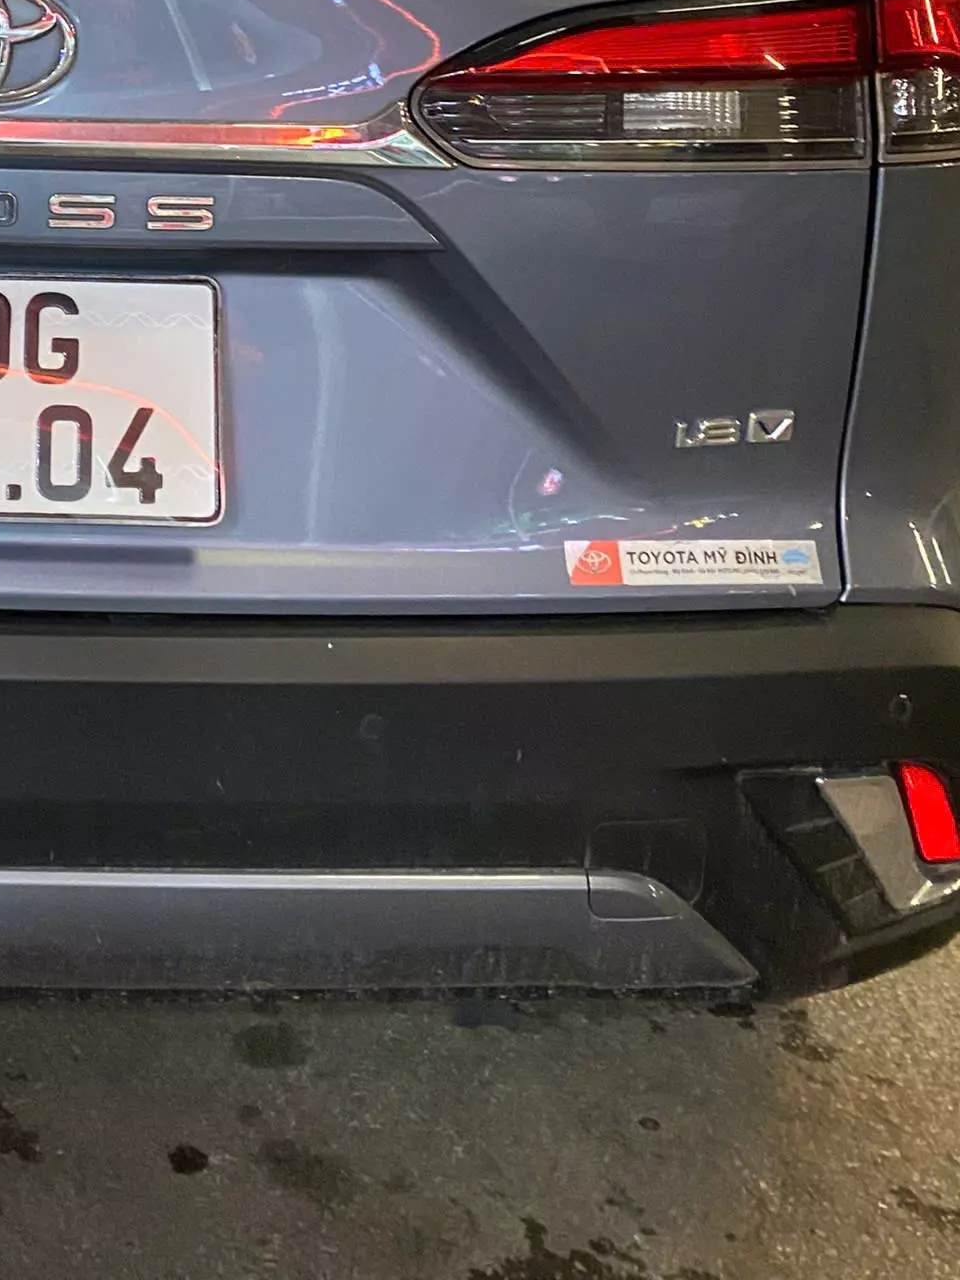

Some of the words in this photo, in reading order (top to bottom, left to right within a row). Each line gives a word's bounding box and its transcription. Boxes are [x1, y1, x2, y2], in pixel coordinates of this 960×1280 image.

[626, 550, 698, 565] TOYOTA
[704, 546, 728, 564] MỸ
[735, 546, 778, 565] ĐÌNH
